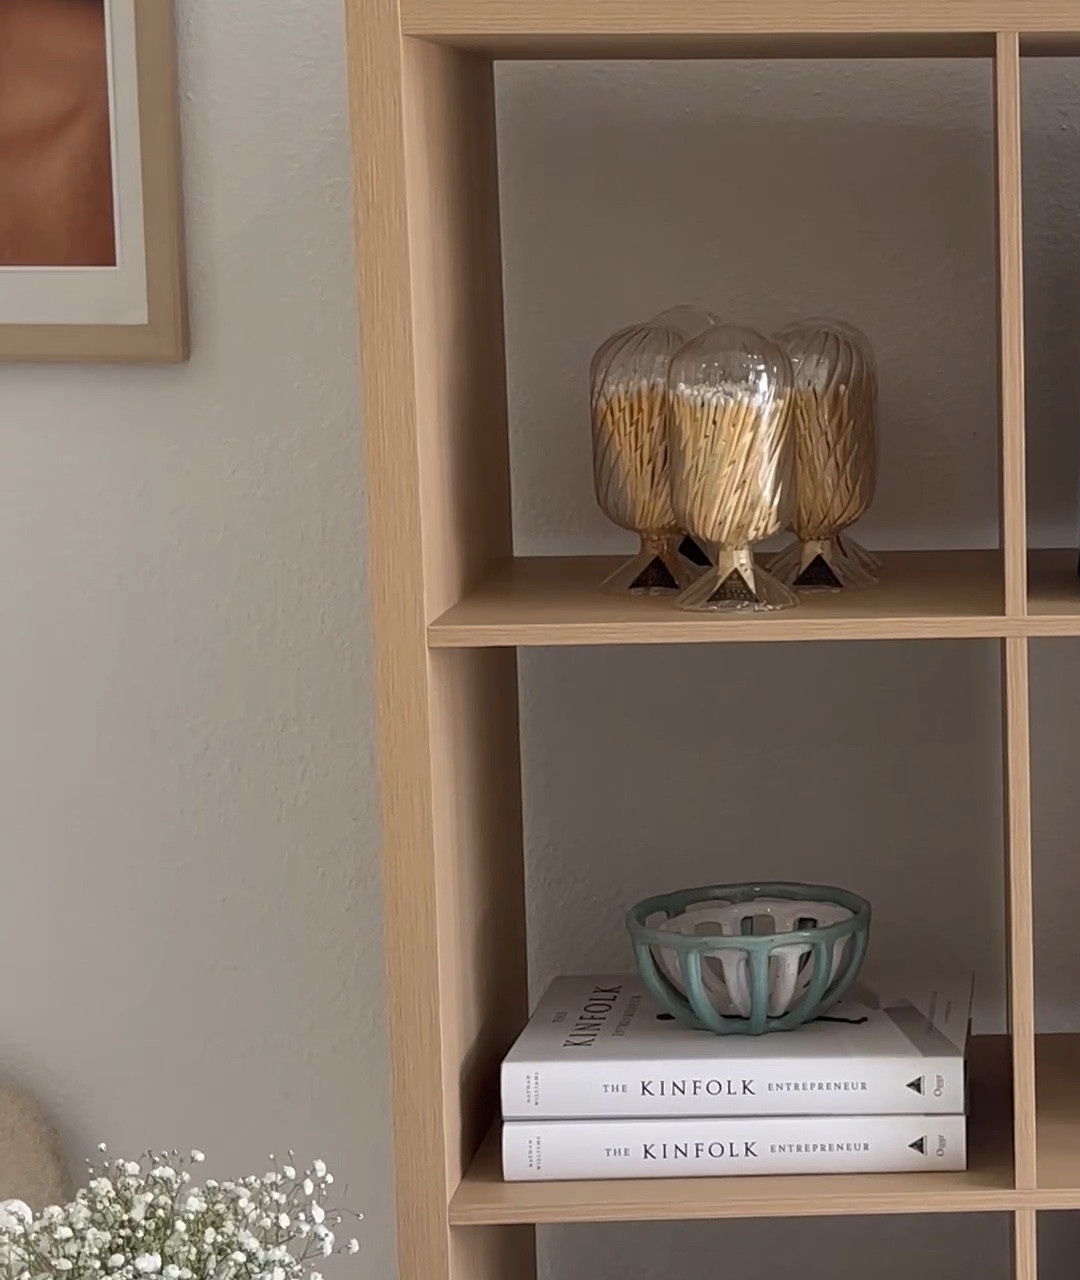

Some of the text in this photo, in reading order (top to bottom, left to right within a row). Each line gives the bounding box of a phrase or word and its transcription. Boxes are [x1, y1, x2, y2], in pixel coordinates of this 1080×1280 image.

[562, 985, 622, 1049] KINFOLK
[602, 1079, 868, 1097] THE KINFOLK ENTREPRENEUR
[604, 1141, 870, 1160] THE KINFOLK ENTREPRENEUR
